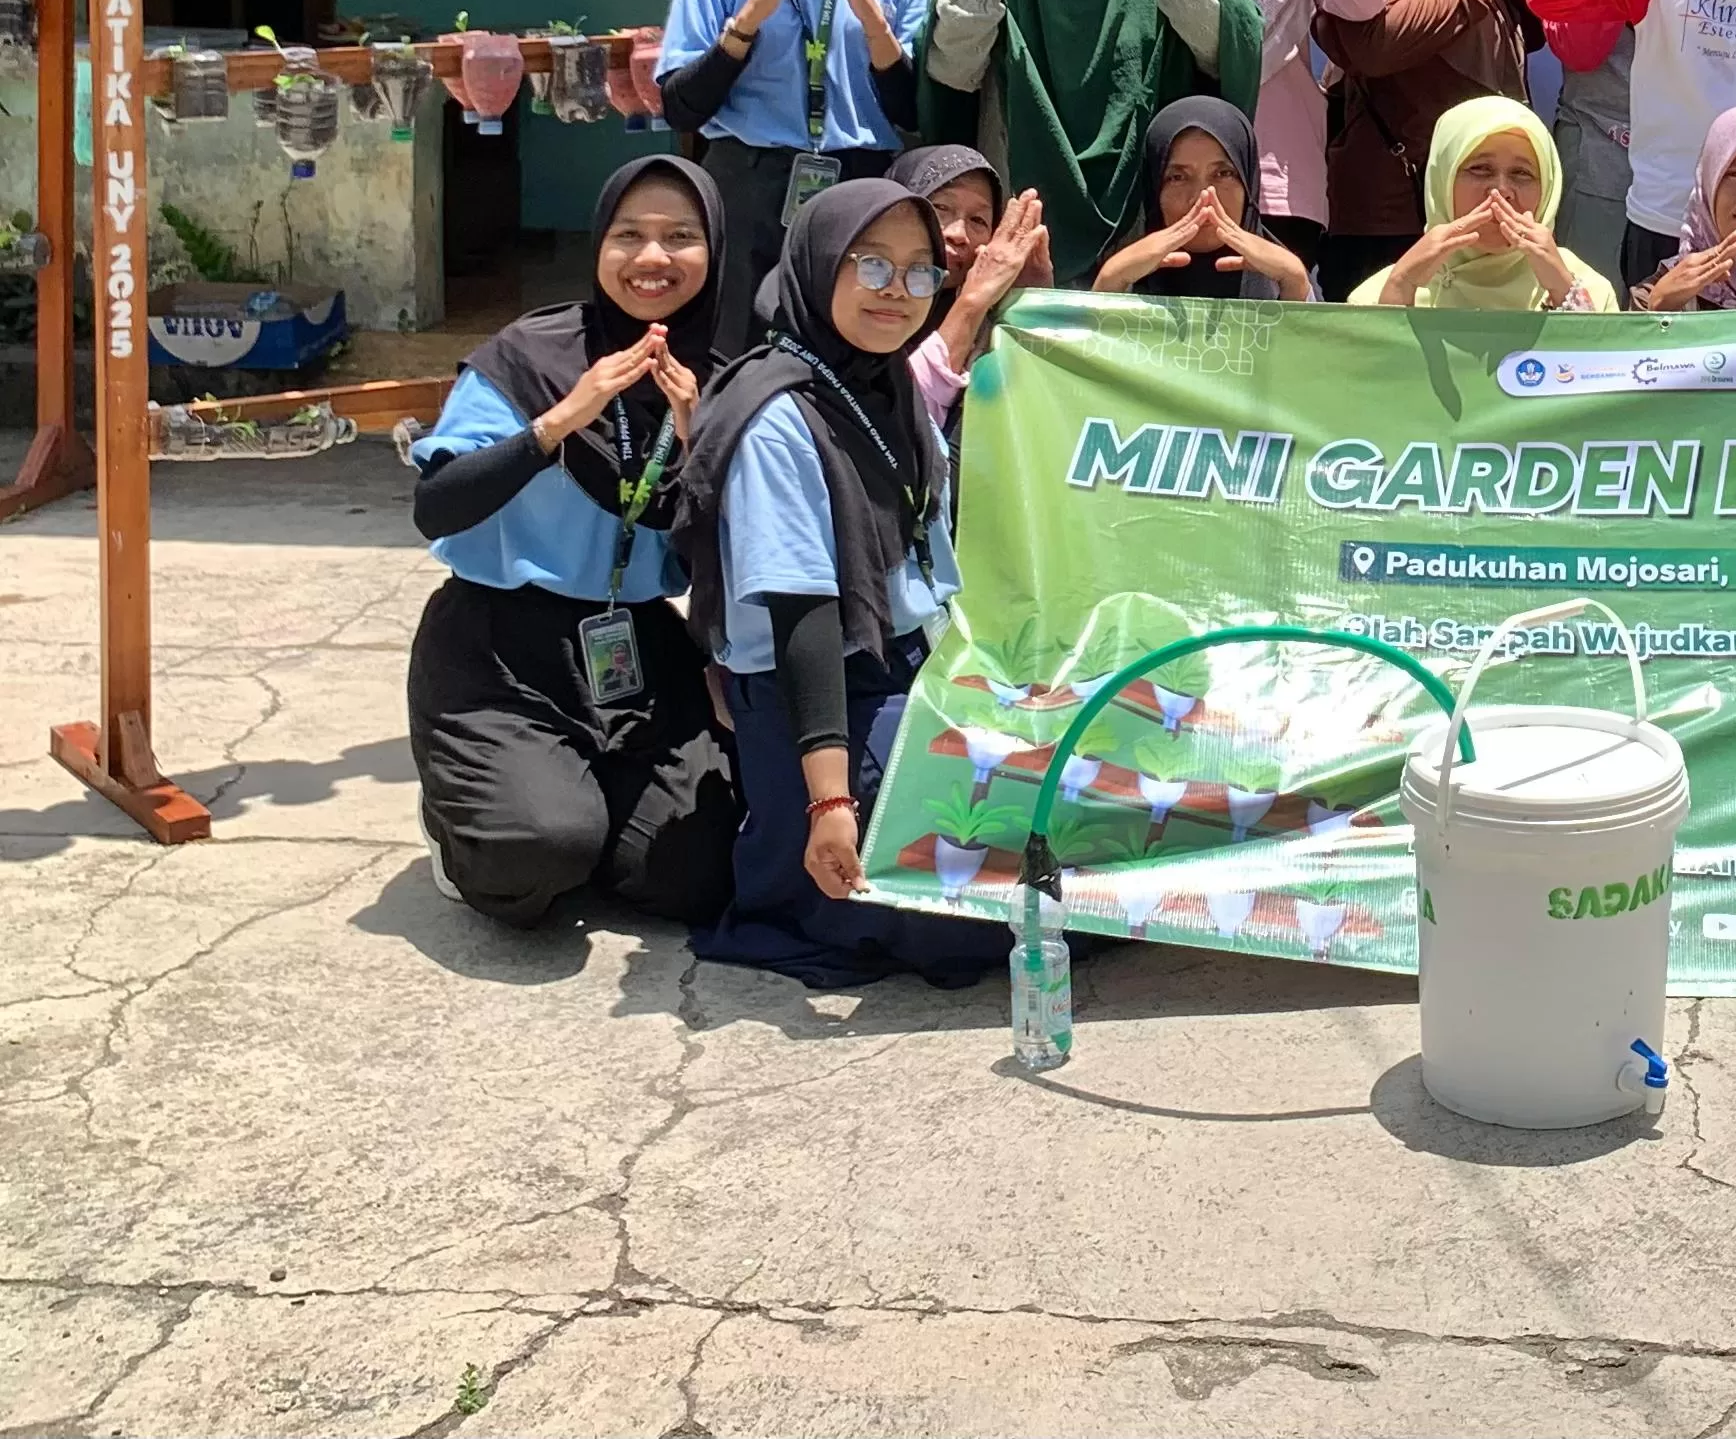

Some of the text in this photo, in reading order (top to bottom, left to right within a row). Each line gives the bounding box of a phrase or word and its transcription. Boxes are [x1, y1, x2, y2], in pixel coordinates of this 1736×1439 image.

[104, 150, 136, 233] UNY
[107, 244, 135, 359] 2025
[618, 415, 630, 440] PPKO
[870, 428, 892, 451] PPKO
[621, 440, 633, 459] TIM
[1065, 417, 1294, 504] MINI
[1305, 439, 1700, 515] GARDEN
[1386, 550, 1567, 581] Padukuhan
[1577, 556, 1728, 588] Mojosari,
